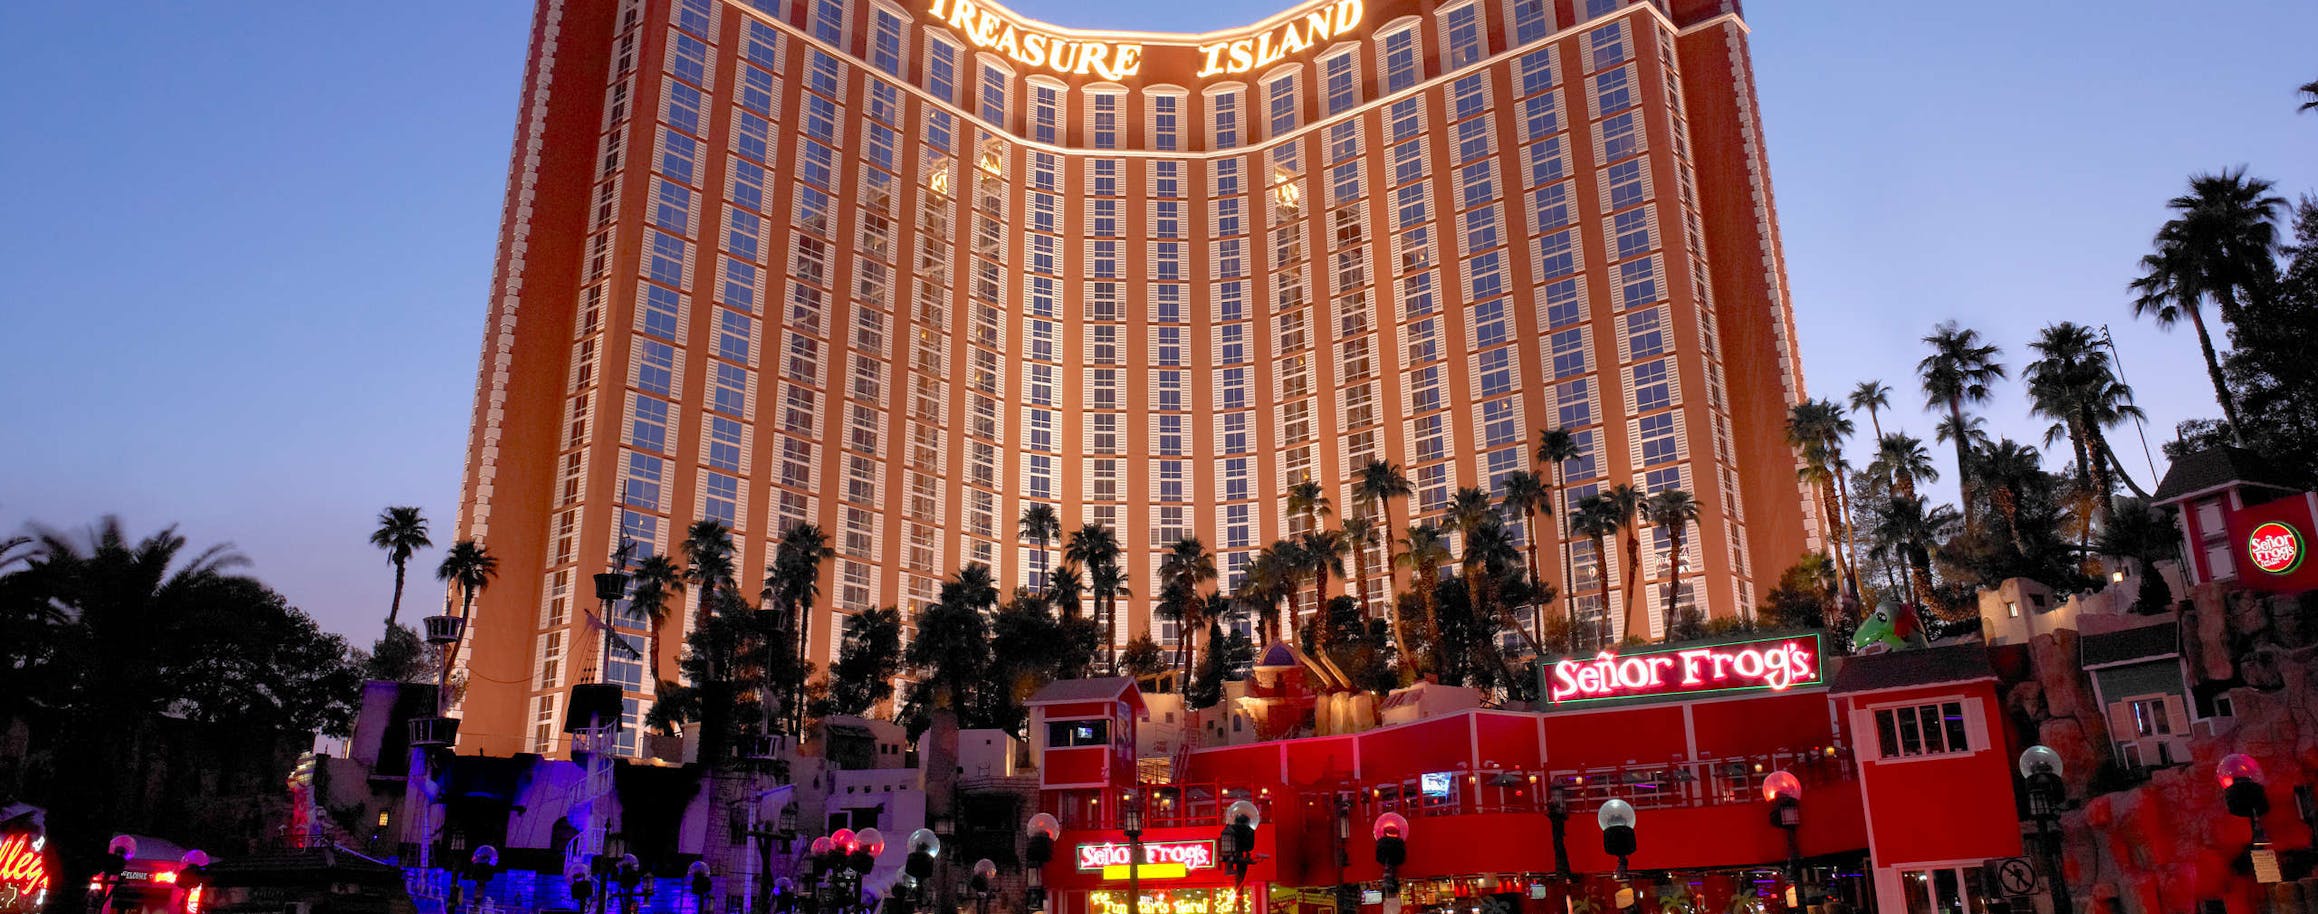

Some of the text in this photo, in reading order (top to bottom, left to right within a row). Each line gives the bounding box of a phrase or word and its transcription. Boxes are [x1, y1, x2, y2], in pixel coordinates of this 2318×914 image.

[1196, 0, 1364, 78] ISLAND
[2252, 534, 2293, 553] Señor
[1552, 651, 1673, 701] Señor
[1080, 842, 1133, 869] Seño
